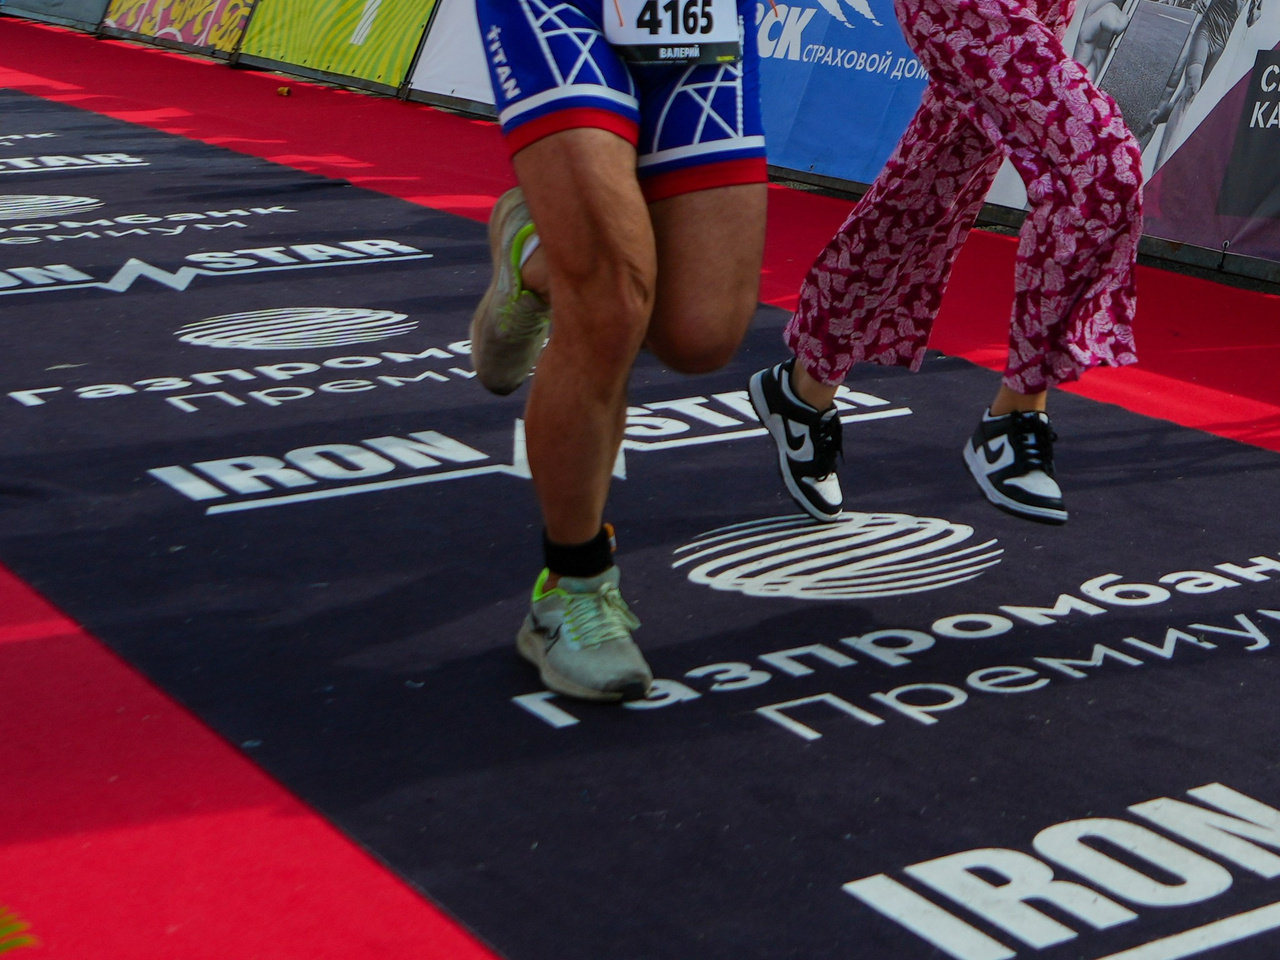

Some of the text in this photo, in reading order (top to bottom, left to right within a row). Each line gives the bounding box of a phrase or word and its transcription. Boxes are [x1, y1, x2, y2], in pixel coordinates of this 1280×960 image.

[486, 24, 522, 100] TITAN
[658, 44, 700, 59] ВАЛЕРИЙ
[802, 44, 894, 74] СТРАХОВОЙ
[0, 153, 144, 170] TAR
[0, 205, 298, 233] омбанк
[185, 239, 423, 269] STAR
[147, 385, 891, 500] IRON ST
